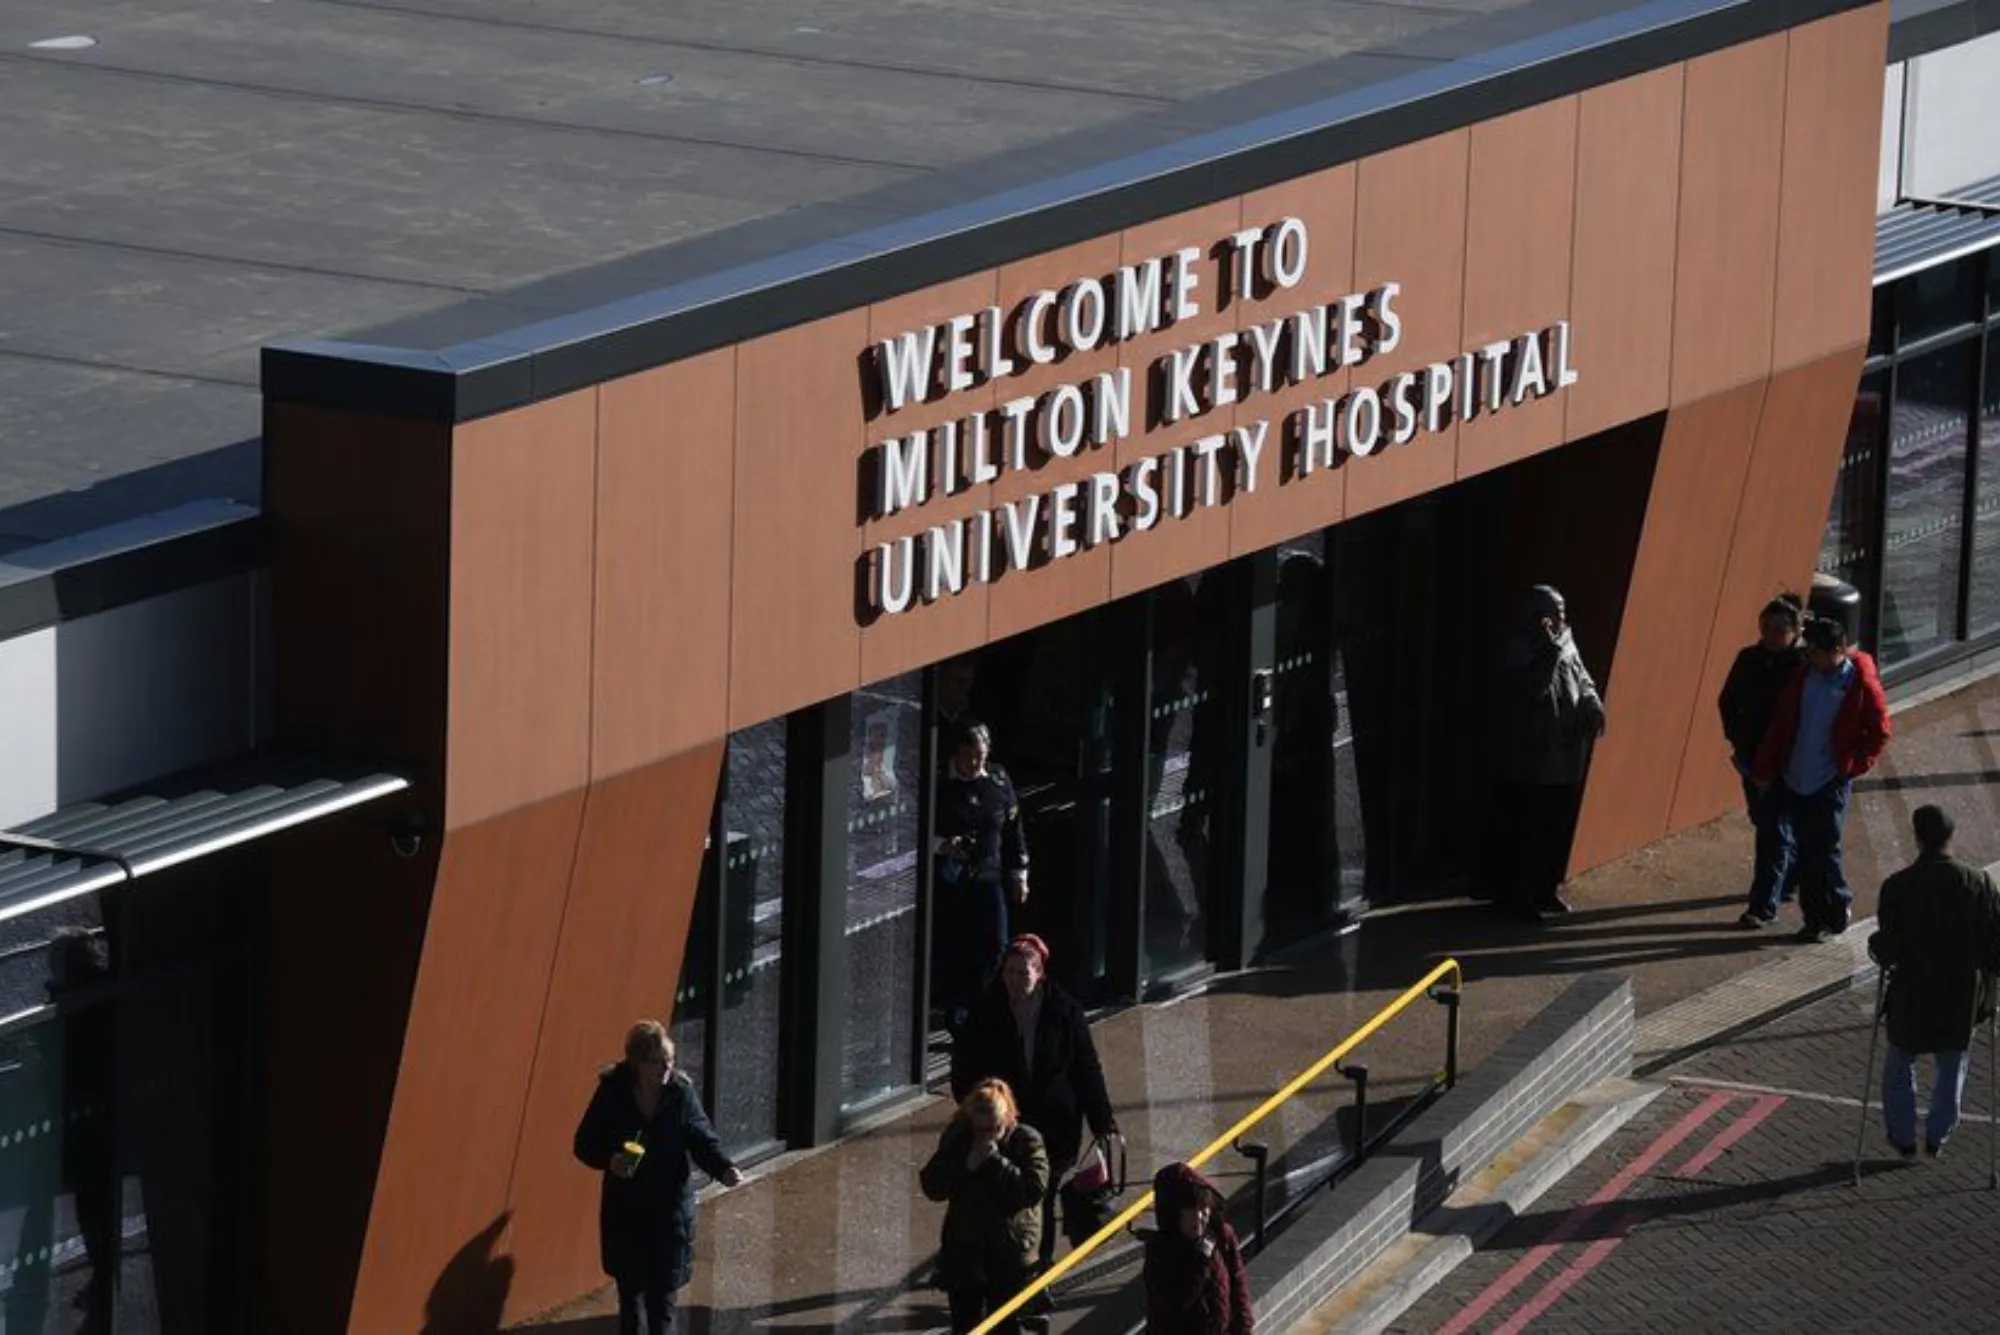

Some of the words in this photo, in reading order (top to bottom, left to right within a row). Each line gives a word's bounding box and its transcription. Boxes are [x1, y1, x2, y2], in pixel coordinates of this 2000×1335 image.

[879, 246, 1200, 411] WELCOME
[1232, 217, 1308, 300] TO
[879, 367, 1130, 515] MILTON
[1164, 282, 1401, 421] KEYNES
[877, 420, 1268, 614] UNIVERSITY
[1298, 320, 1578, 476] HOSPITAL
